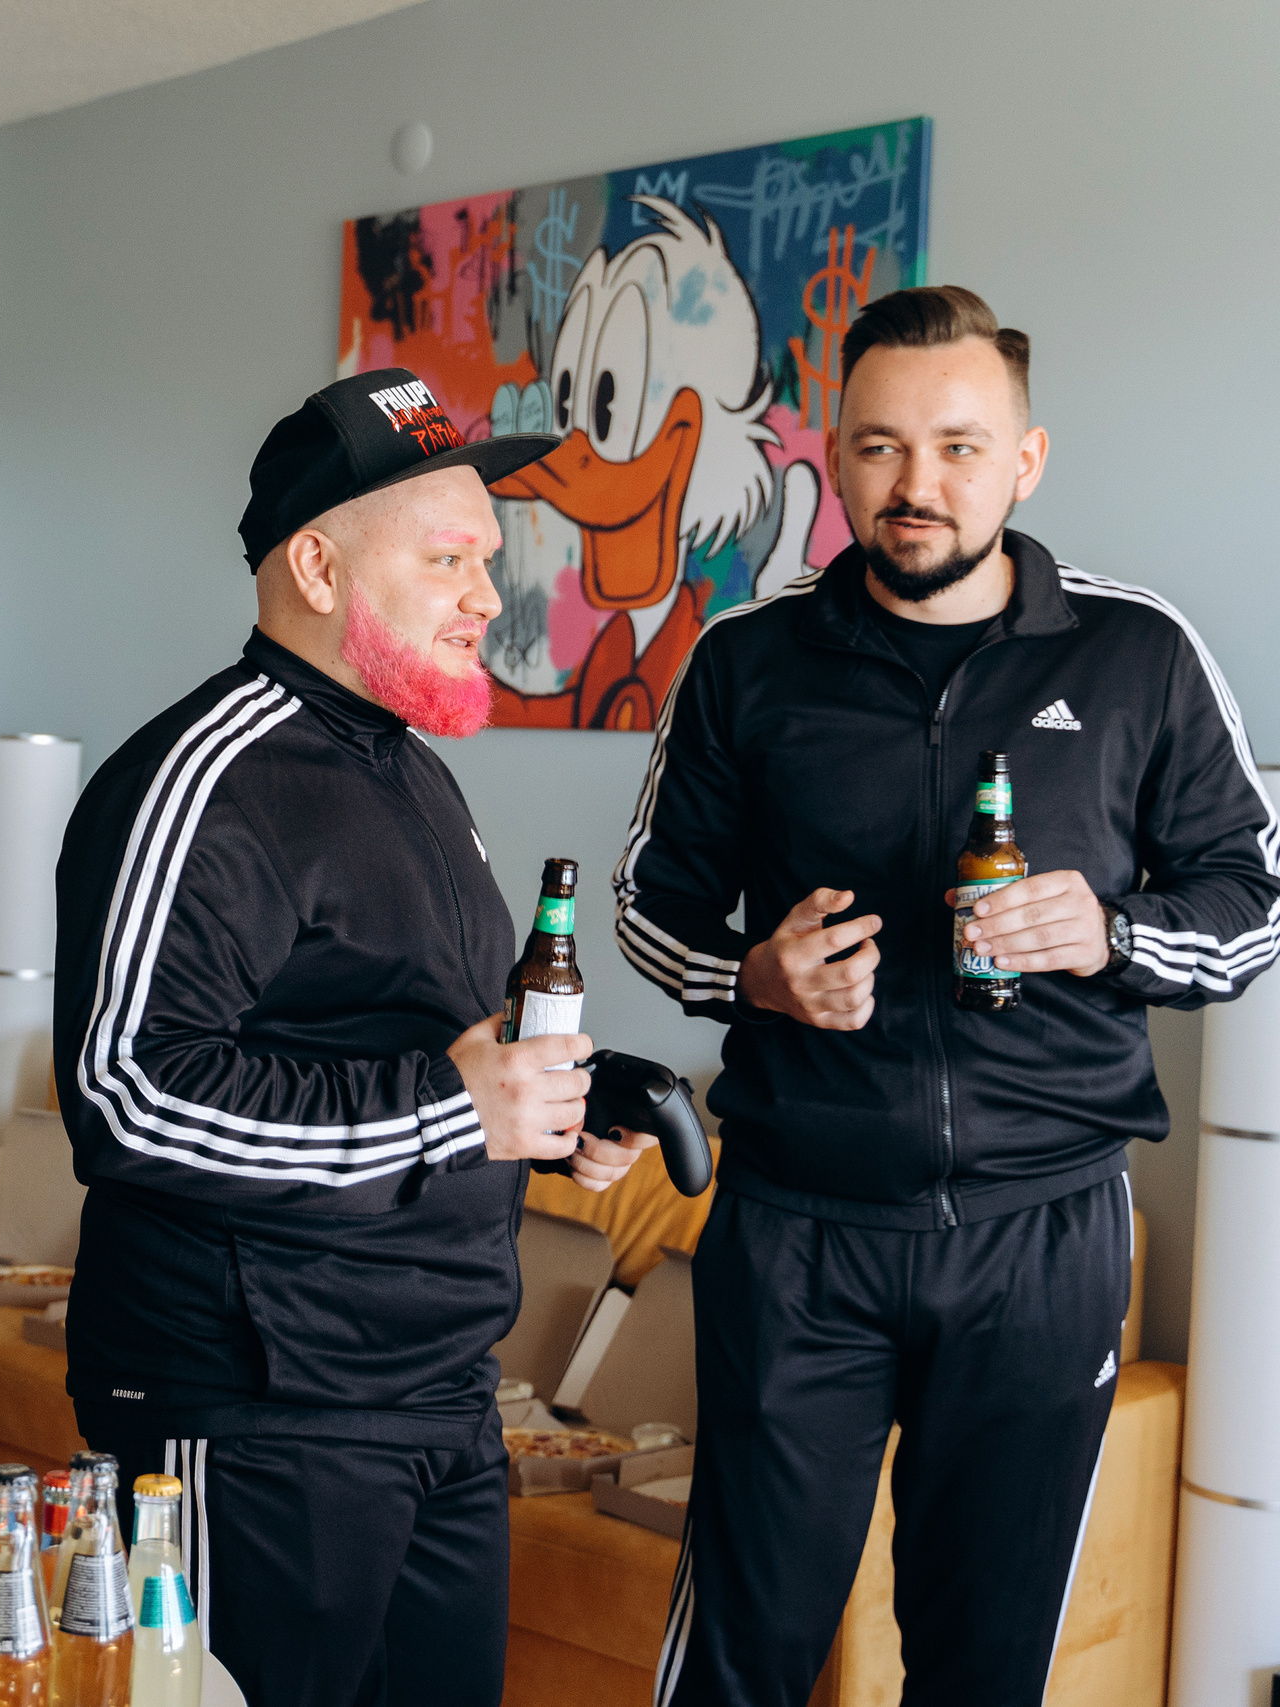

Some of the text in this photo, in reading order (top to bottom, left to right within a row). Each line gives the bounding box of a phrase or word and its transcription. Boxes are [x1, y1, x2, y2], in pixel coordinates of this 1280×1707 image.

[1031, 717, 1082, 731] adidas
[963, 949, 990, 969] 420
[112, 1388, 145, 1400] AEROREADY
